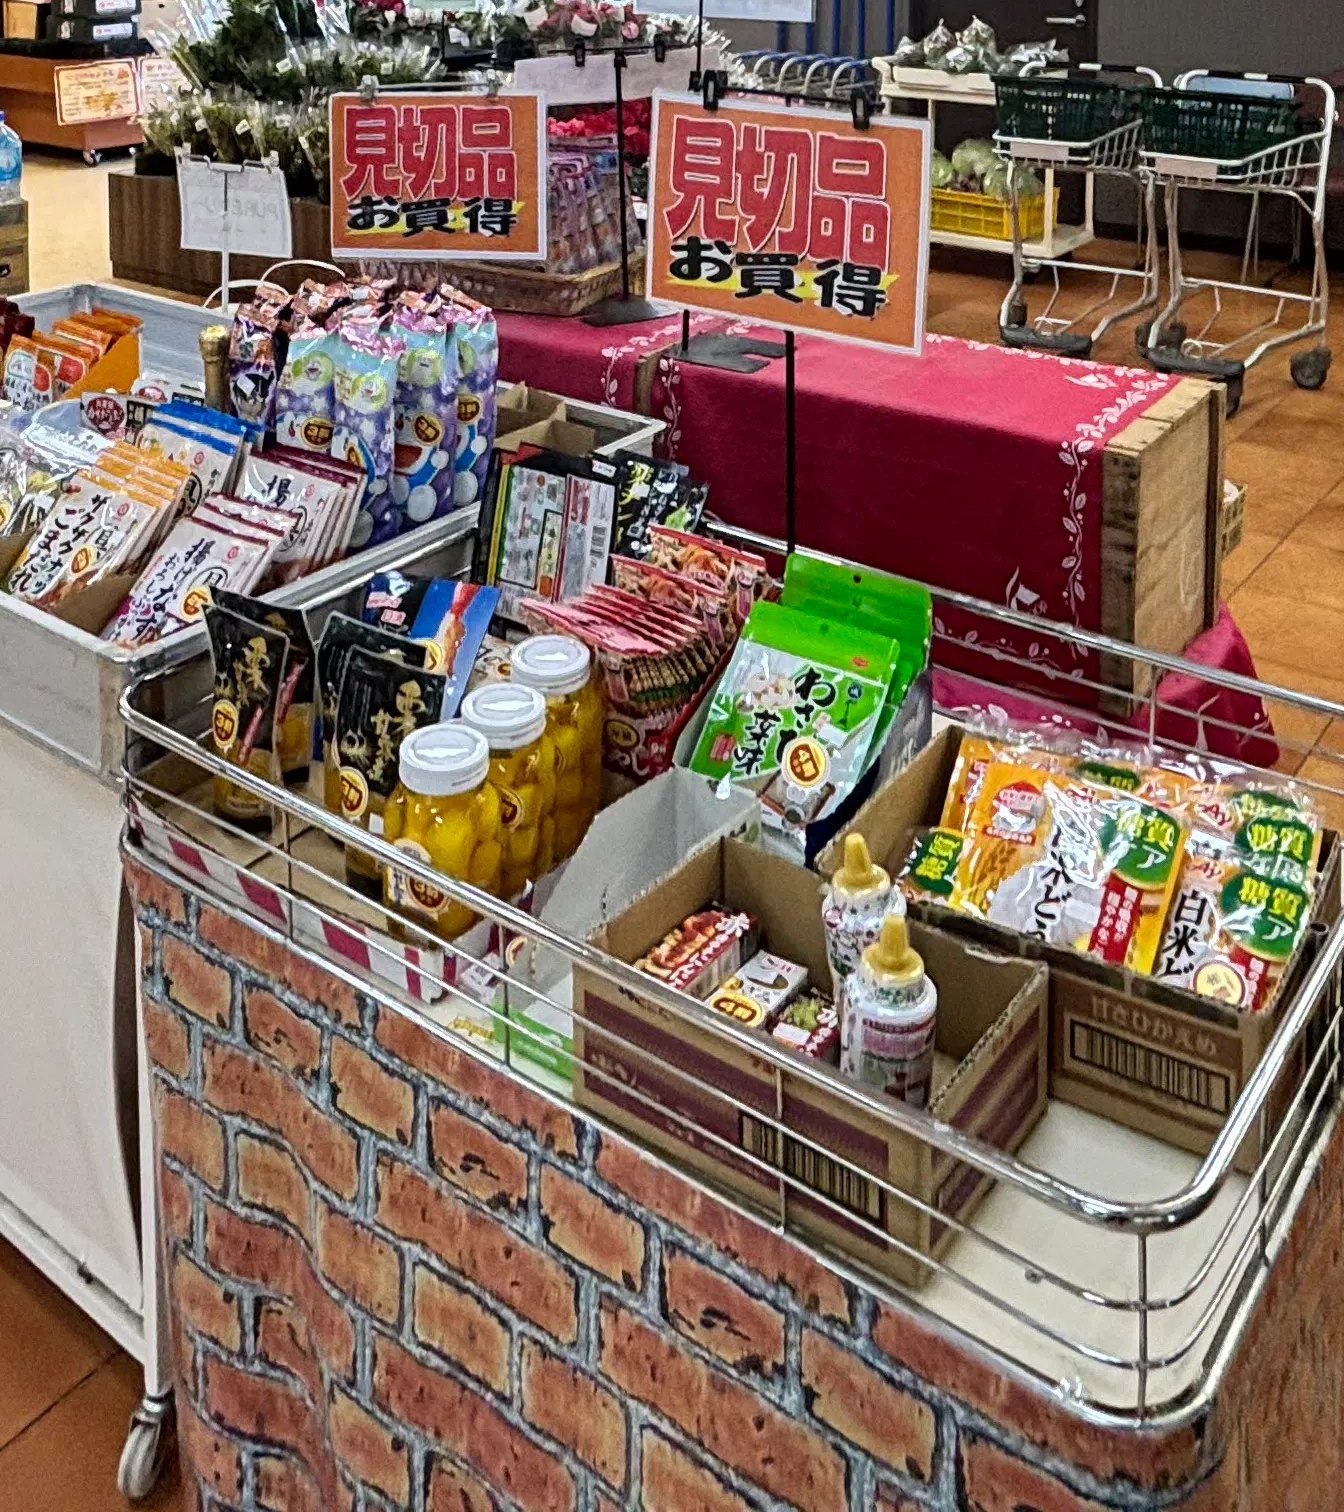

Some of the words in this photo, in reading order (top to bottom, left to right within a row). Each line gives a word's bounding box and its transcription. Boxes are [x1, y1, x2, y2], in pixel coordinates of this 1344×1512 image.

[342, 105, 517, 199] 見切品
[347, 197, 517, 236] お買得
[662, 115, 890, 270] 見切品
[671, 236, 886, 318] お買得
[914, 833, 960, 882] 糖質
[1092, 995, 1217, 1057] 甘さひかえめ
